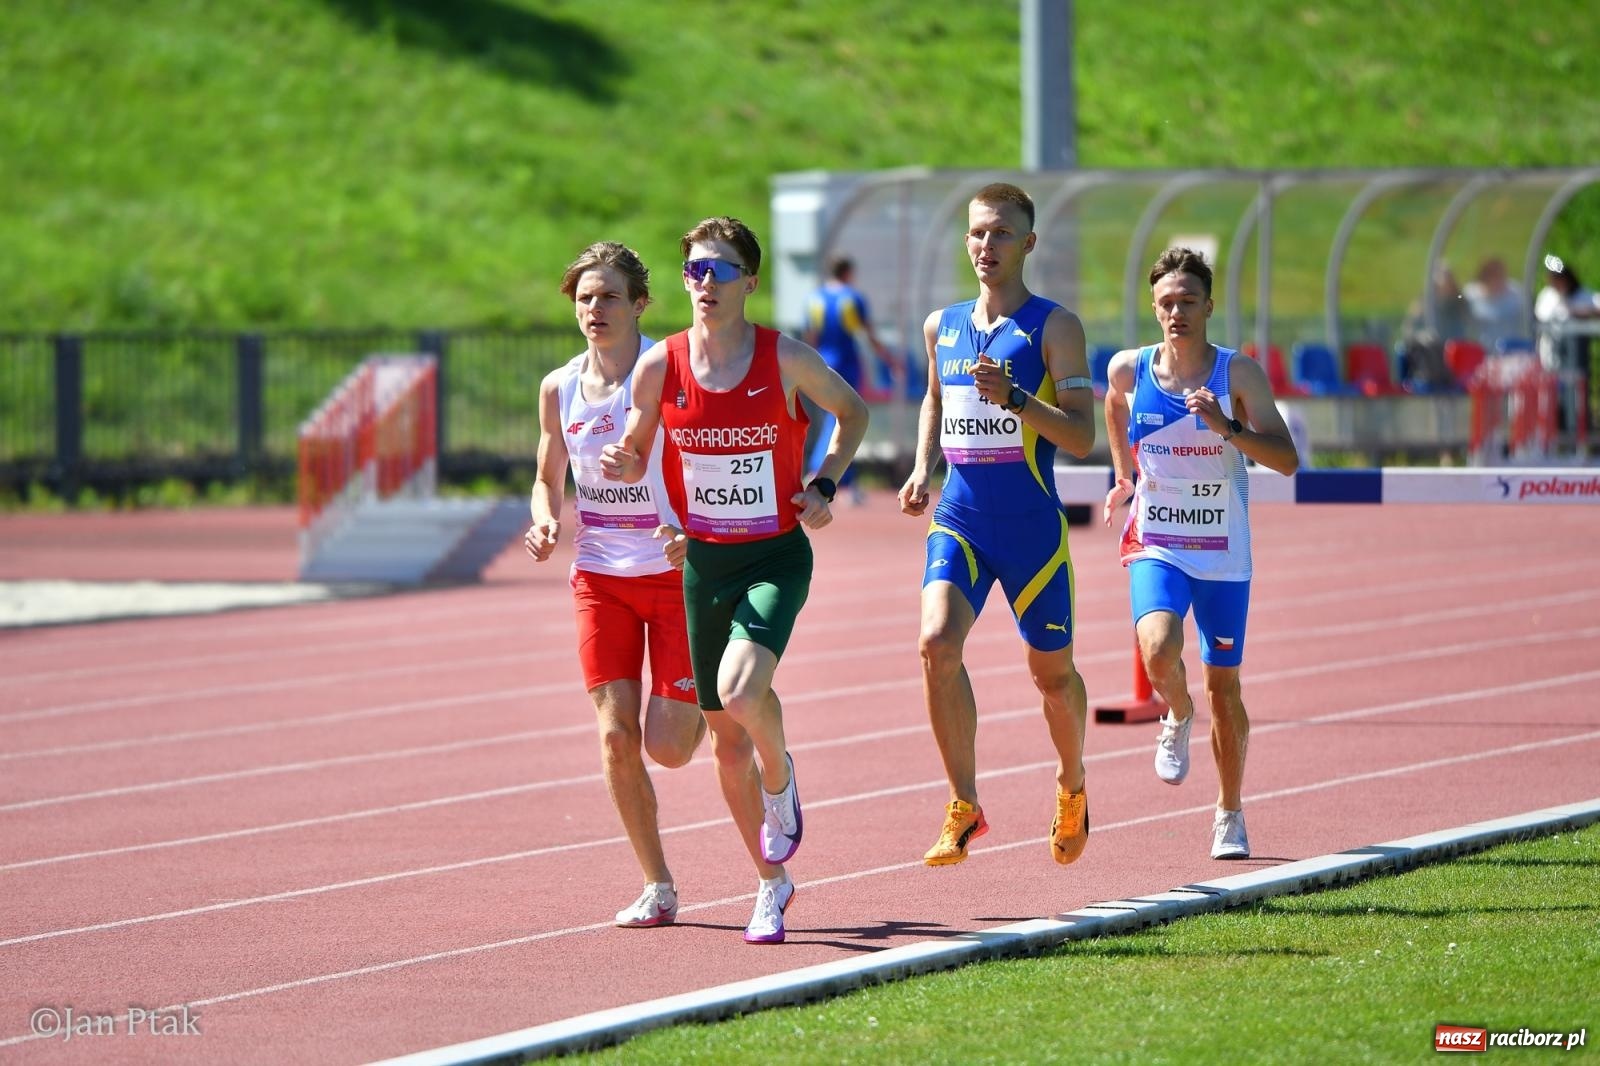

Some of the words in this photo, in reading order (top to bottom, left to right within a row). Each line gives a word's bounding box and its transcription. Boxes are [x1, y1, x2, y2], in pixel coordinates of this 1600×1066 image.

[567, 421, 585, 435] 4F
[944, 417, 1018, 435] LYSENKO
[1142, 442, 1170, 455] CZECH
[1172, 445, 1223, 456] REPUBLIC
[730, 456, 764, 475] 257
[694, 484, 764, 506] ACSÁDI
[1191, 483, 1222, 497] 157
[1147, 505, 1225, 525] SCHMIDT
